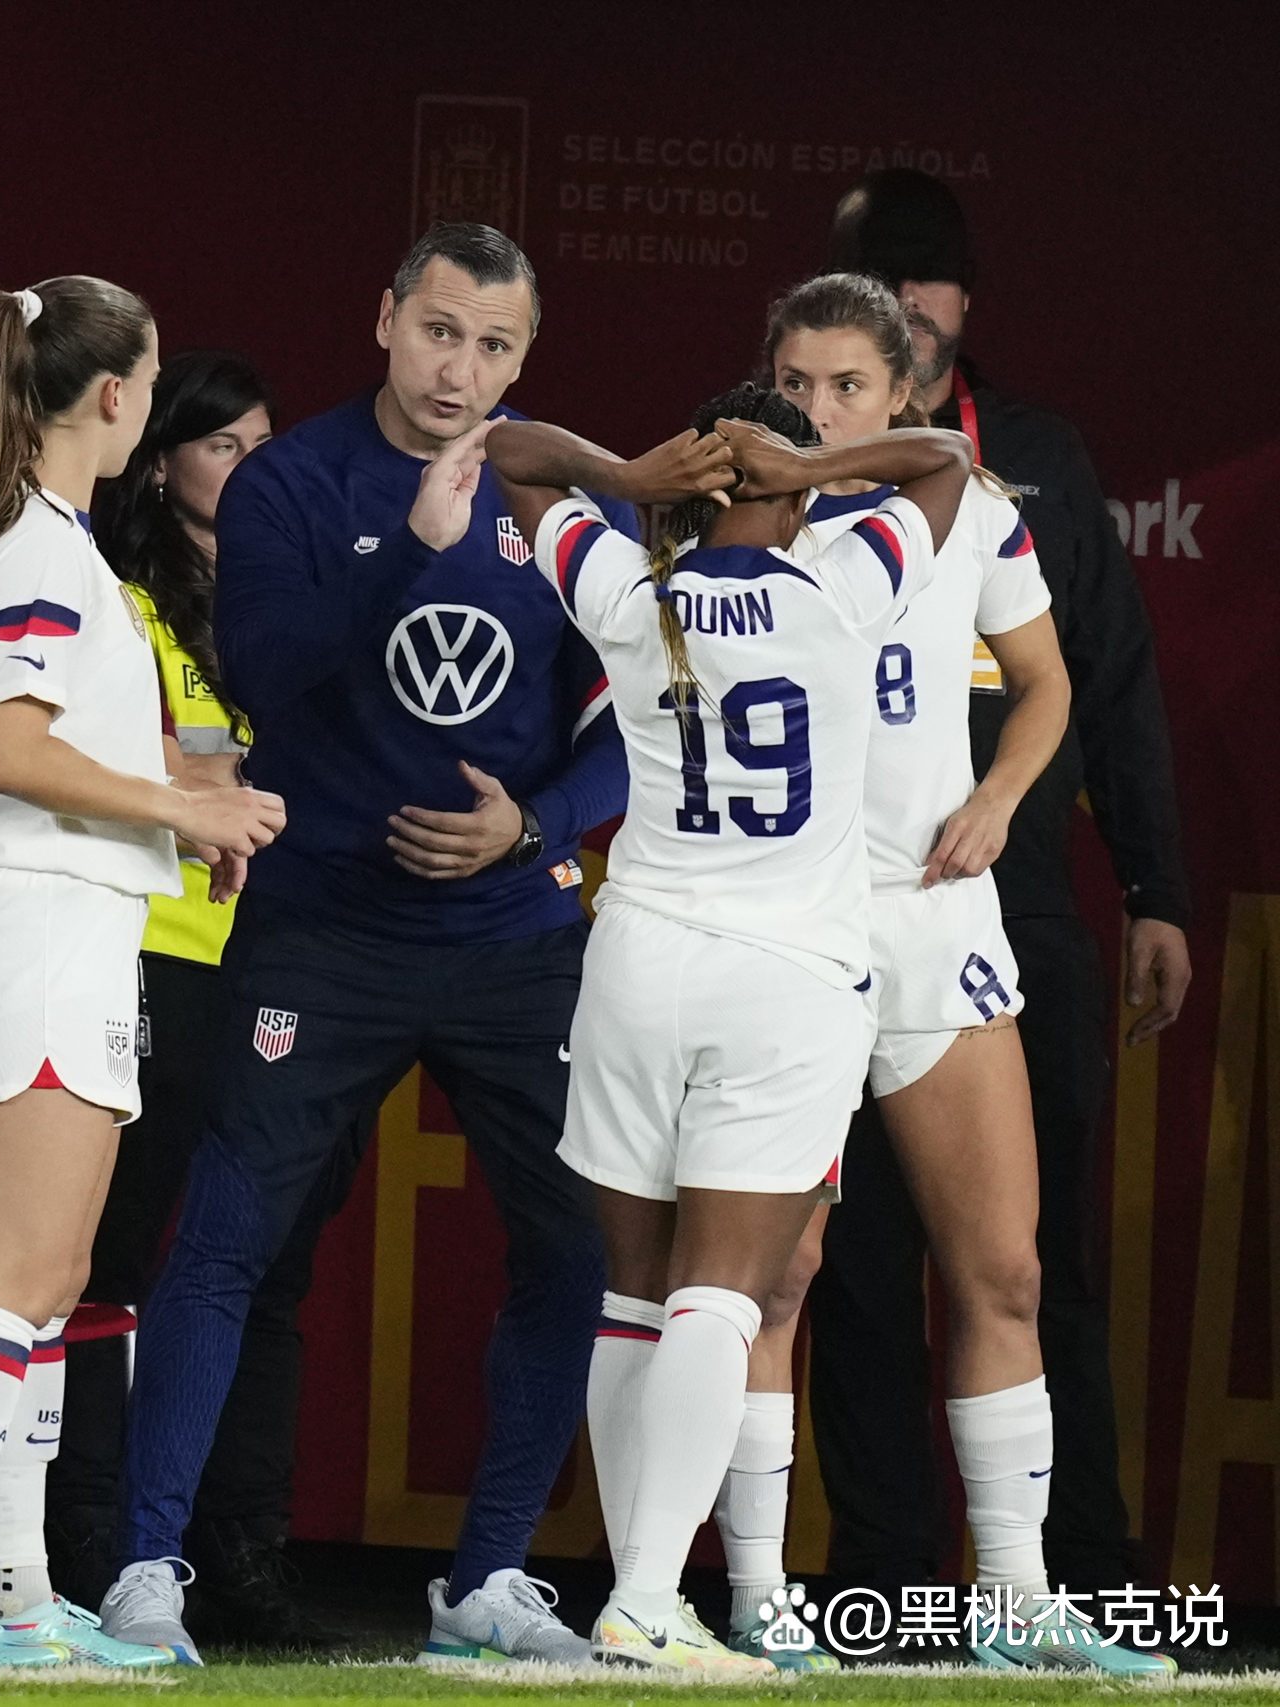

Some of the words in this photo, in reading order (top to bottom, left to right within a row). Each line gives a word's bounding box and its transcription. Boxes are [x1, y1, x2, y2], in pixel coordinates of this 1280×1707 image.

[562, 132, 776, 172] SELECCIÓN
[790, 141, 992, 179] ESPAÑOLA
[559, 184, 606, 212] DE
[622, 178, 769, 220] FÚTBOL
[557, 232, 749, 267] FEMENINO
[359, 536, 381, 548] NIKE
[671, 588, 774, 637] DUNN
[876, 643, 917, 726] 8
[658, 676, 812, 838] 19
[960, 952, 1011, 1023] 8
[260, 1009, 296, 1032] USA
[108, 1034, 128, 1055] USA
[37, 1410, 62, 1424] US
